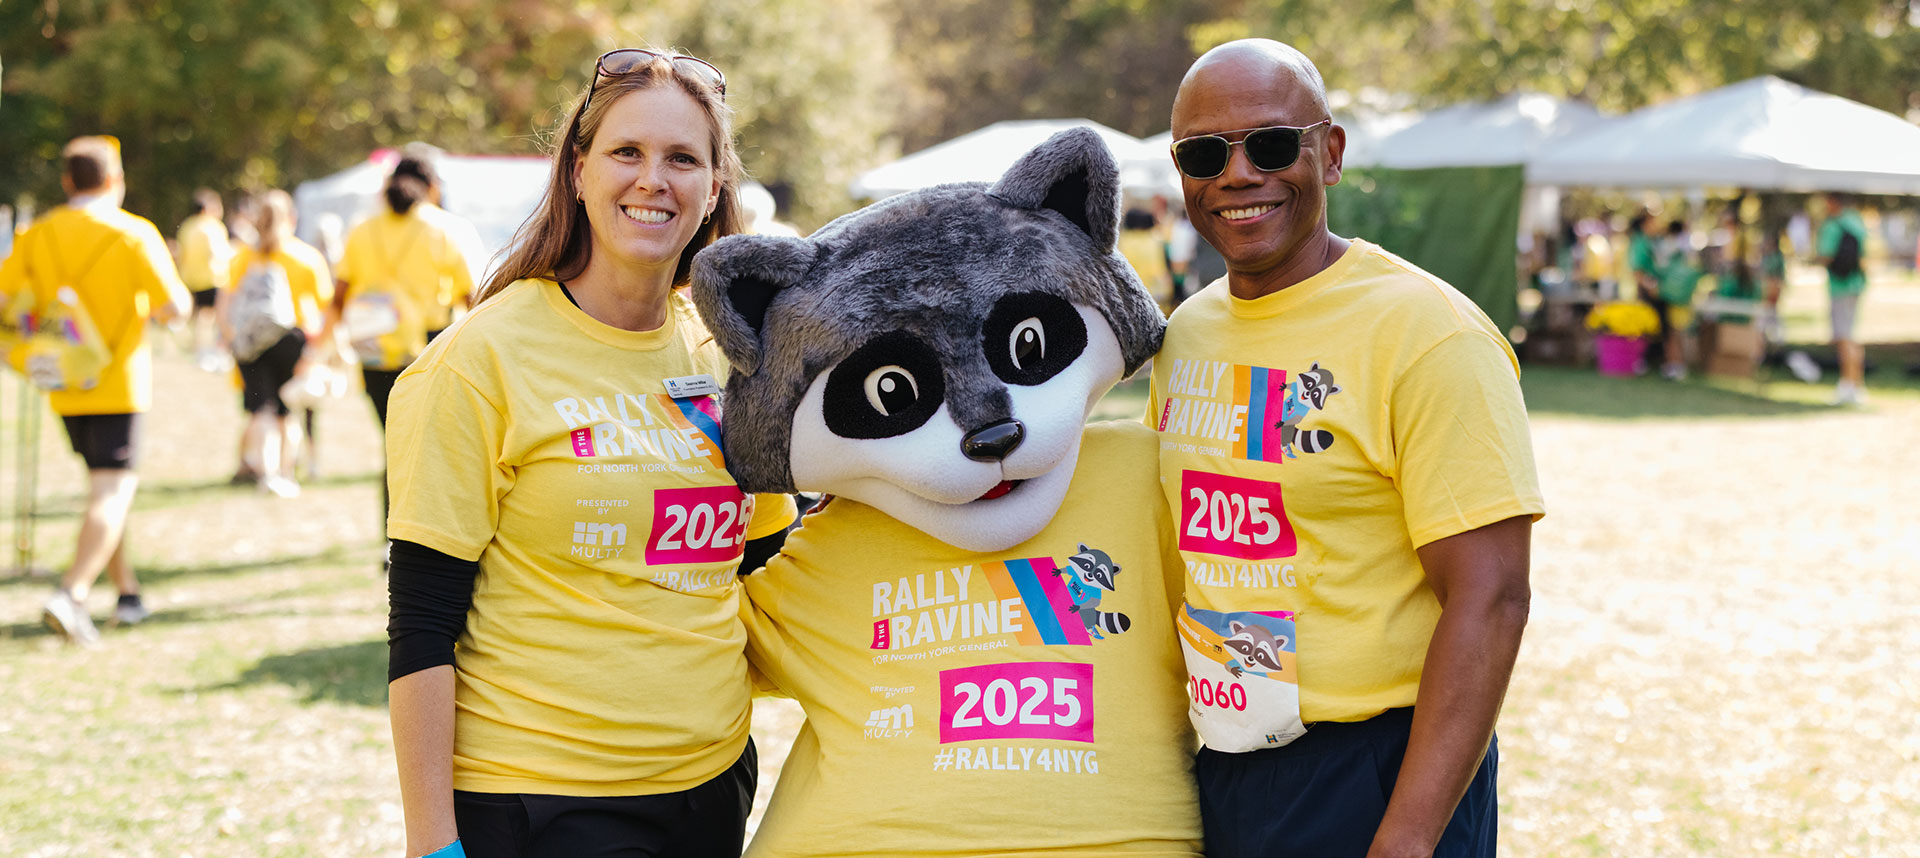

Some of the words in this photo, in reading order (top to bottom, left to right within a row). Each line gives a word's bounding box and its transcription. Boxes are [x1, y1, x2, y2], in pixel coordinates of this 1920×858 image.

[1167, 358, 1228, 398] RALLY
[553, 393, 654, 430] RALLY
[1165, 397, 1248, 442] RAVINE
[577, 431, 586, 446] THE
[1178, 443, 1197, 453] YORK
[1198, 446, 1226, 458] GENERAL
[577, 464, 600, 474] FOR
[603, 463, 638, 473] NORTH
[641, 463, 667, 472] YORK
[576, 499, 629, 507] PRESENTED
[1186, 487, 1281, 546] 2025
[656, 501, 750, 551] 2025
[571, 545, 624, 559] MULTY
[872, 565, 973, 618] RALLY
[891, 597, 1023, 650] RAVINE
[872, 654, 888, 666] FOR
[890, 652, 926, 661] NORTH
[928, 645, 956, 657] YORK
[958, 639, 1008, 652] GENERAL
[870, 685, 915, 694] PRESENTED
[885, 691, 897, 699] BY
[952, 677, 1082, 728] 2025
[864, 728, 913, 740] MULTY
[933, 747, 1099, 774] #RALLY4NYG
